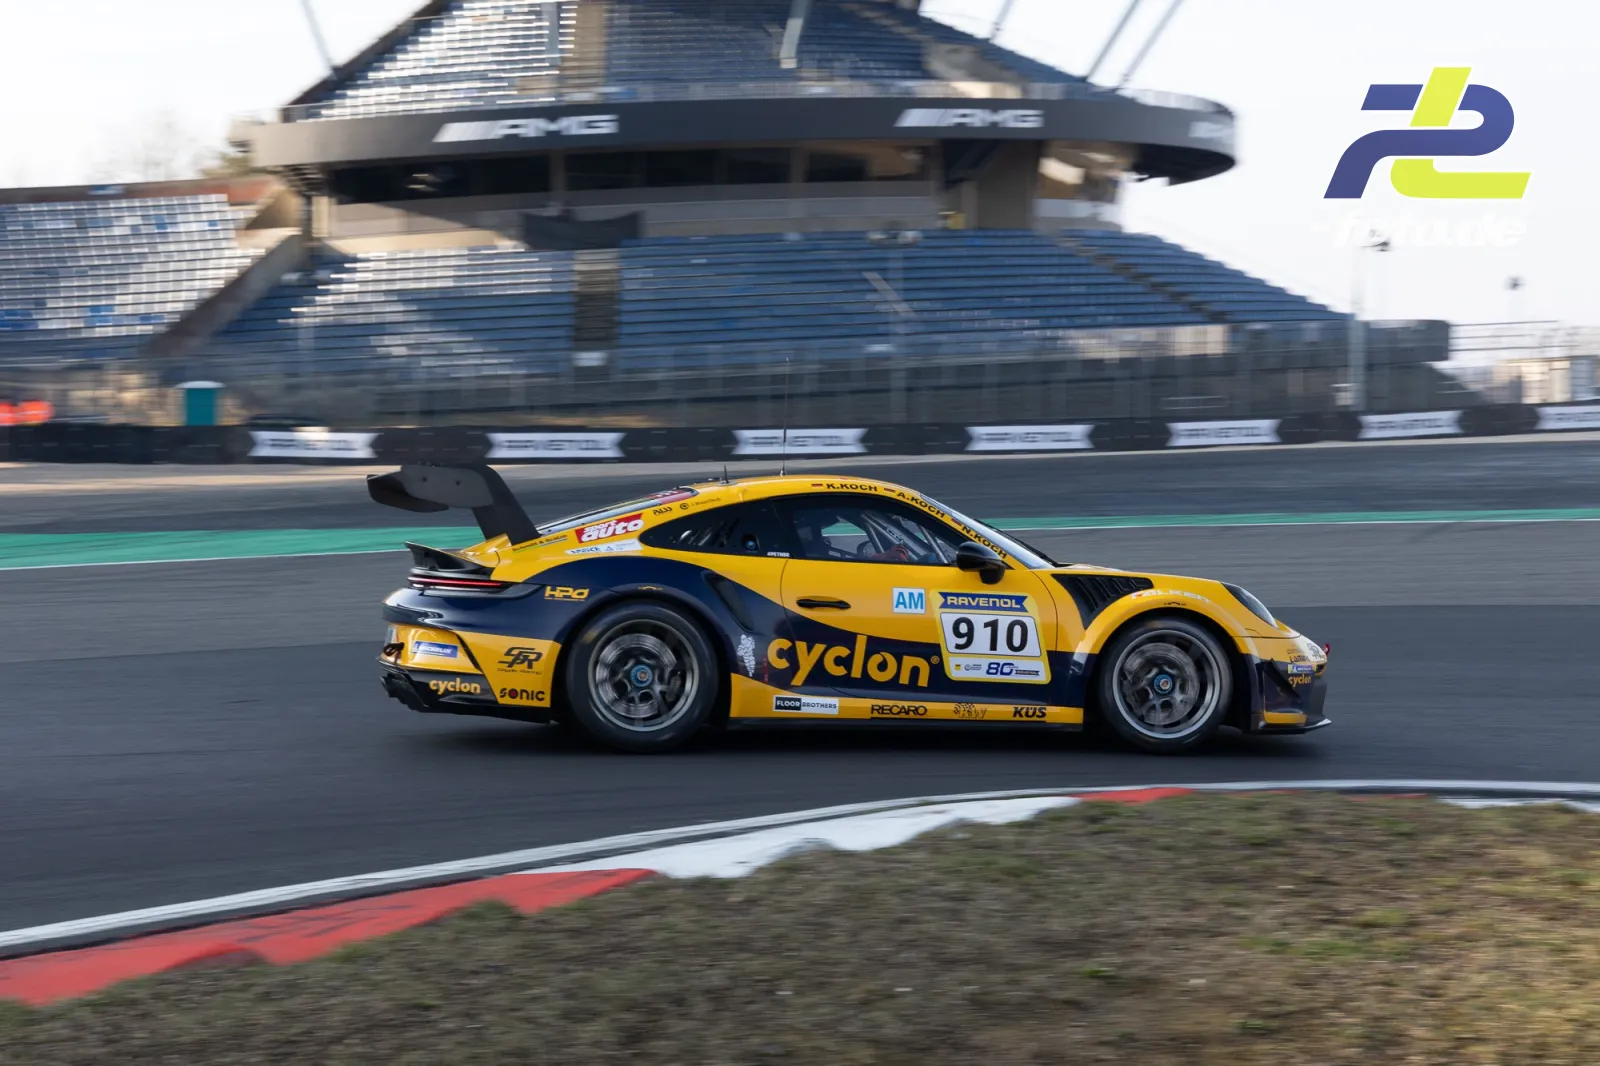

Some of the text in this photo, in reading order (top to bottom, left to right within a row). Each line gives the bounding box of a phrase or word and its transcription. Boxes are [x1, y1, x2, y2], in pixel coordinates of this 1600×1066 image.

[490, 114, 619, 139] AMG
[944, 109, 1044, 128] AMG
[826, 483, 878, 492] K.KOCH
[897, 491, 946, 519] A.KOCH
[580, 518, 645, 543] auto
[961, 525, 1008, 560] N.KOCH
[894, 591, 924, 610] AM
[946, 596, 1021, 608] RAVENOL
[952, 616, 1029, 653] 910
[986, 662, 1016, 676] 80
[429, 677, 481, 695] cyclon
[776, 699, 837, 710] FLOOR BROTHERS
[870, 704, 928, 716] RECARO
[1012, 706, 1047, 719] KÜS
